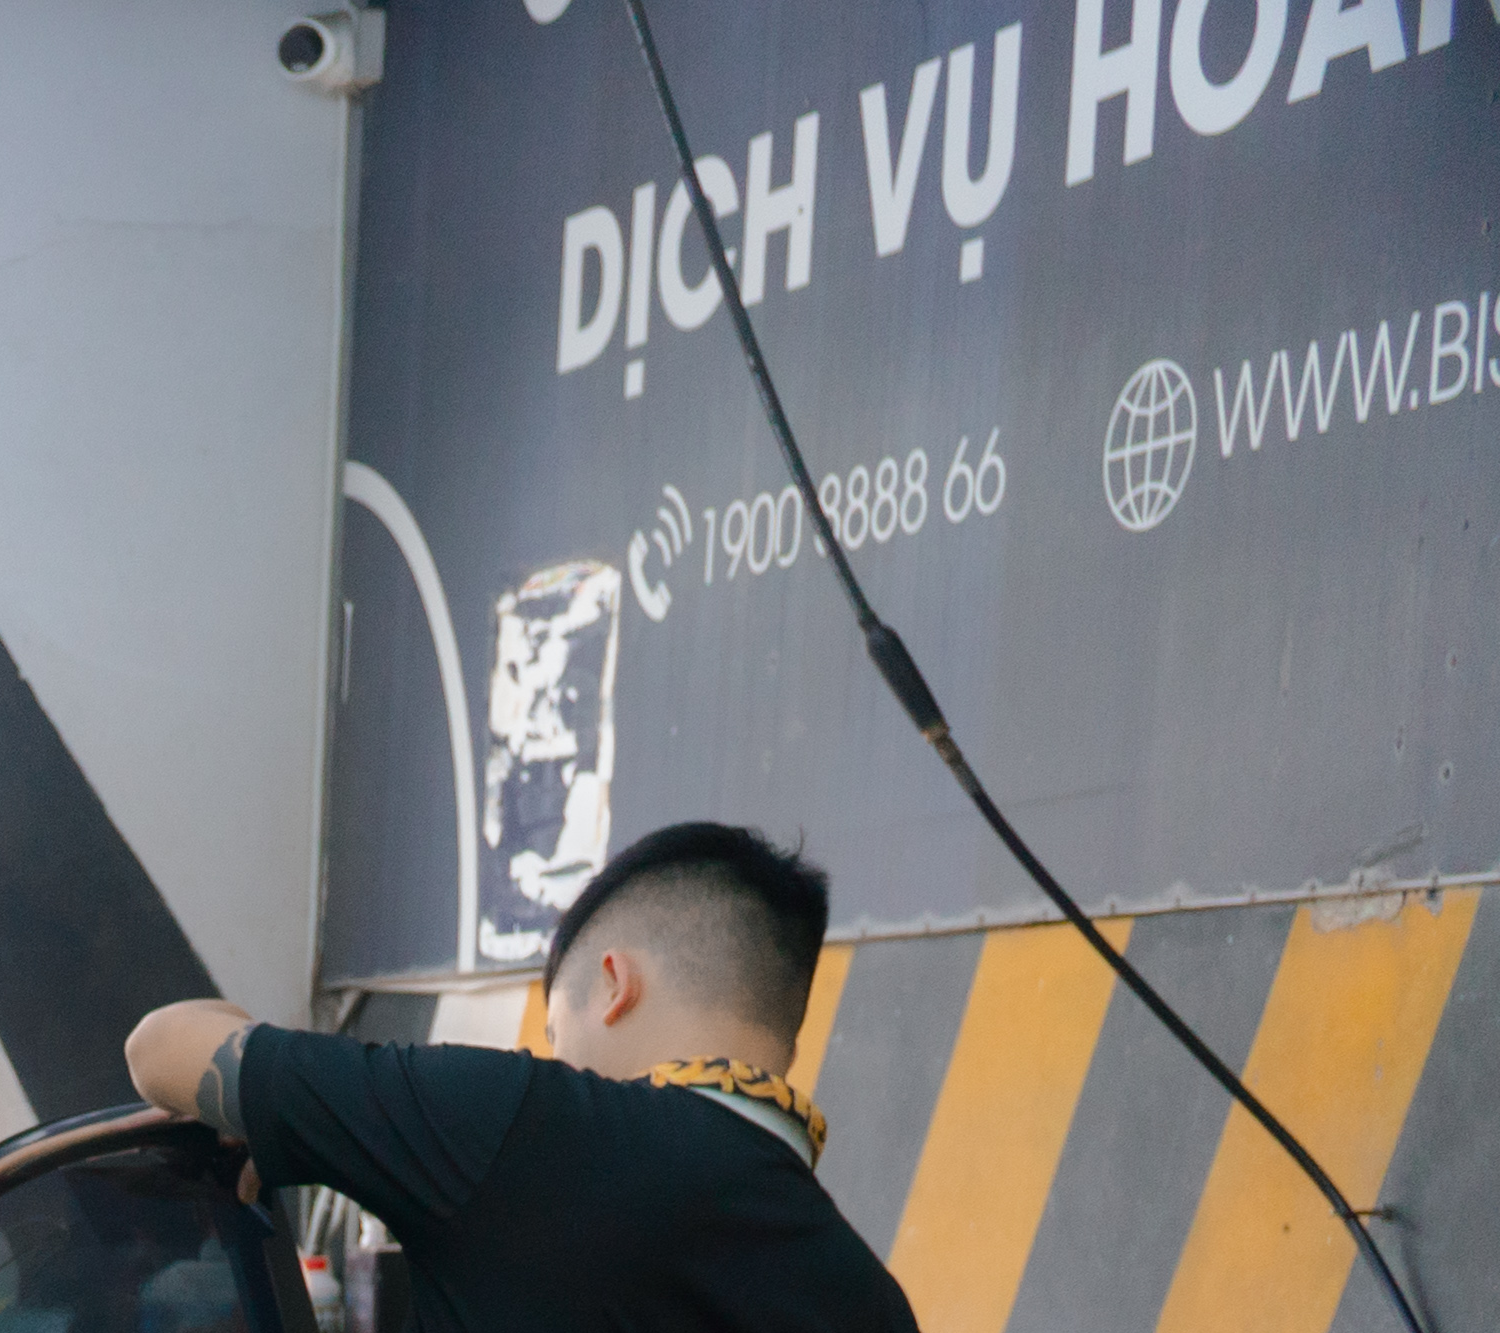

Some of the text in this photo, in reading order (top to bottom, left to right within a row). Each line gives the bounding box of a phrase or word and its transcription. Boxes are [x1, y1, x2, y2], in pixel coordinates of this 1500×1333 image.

[556, 110, 820, 400] DỊCH
[859, 20, 1023, 283] VỤ
[704, 484, 804, 586] 1900
[943, 427, 1007, 523] 66
